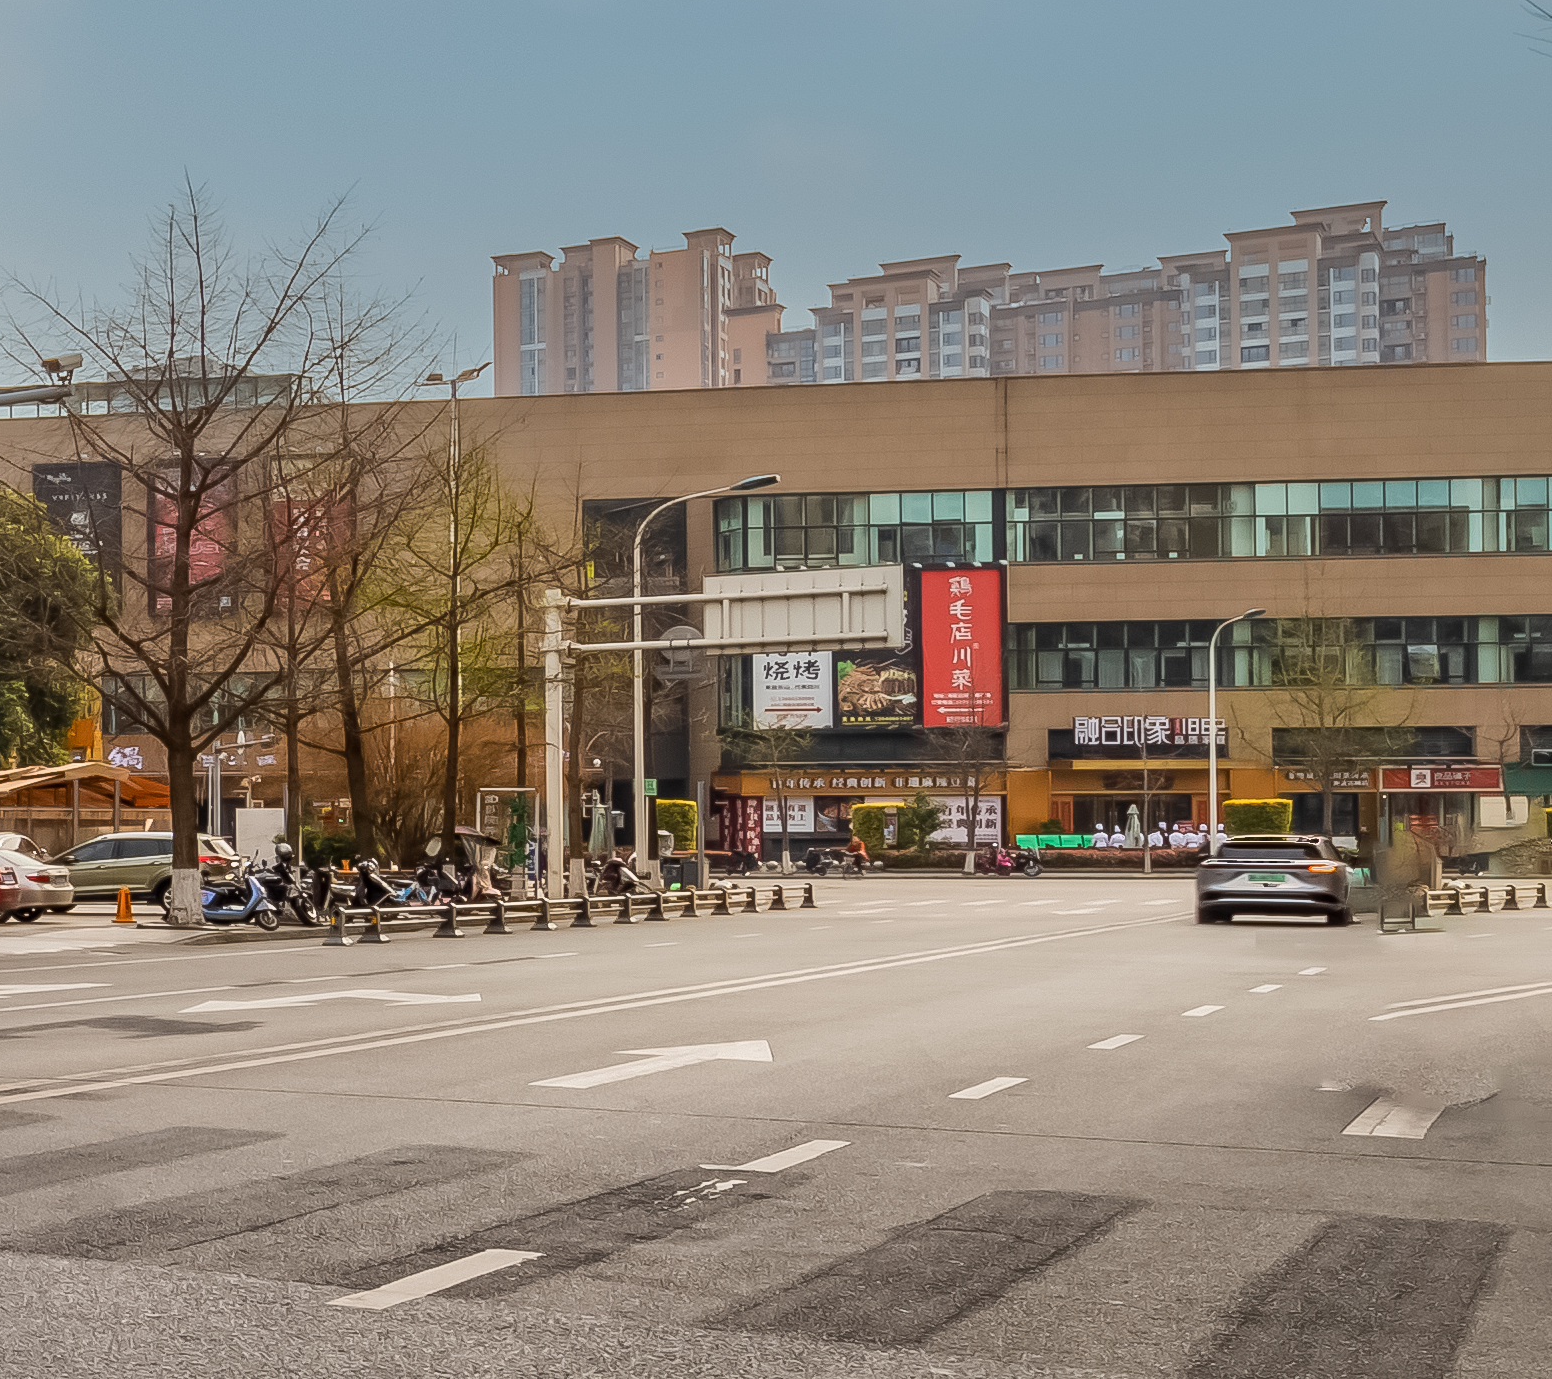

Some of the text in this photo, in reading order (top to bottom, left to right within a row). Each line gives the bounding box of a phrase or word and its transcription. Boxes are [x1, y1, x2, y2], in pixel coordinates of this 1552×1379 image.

[763, 660, 821, 680] 烧烤
[1075, 716, 1171, 747] 融合印象
